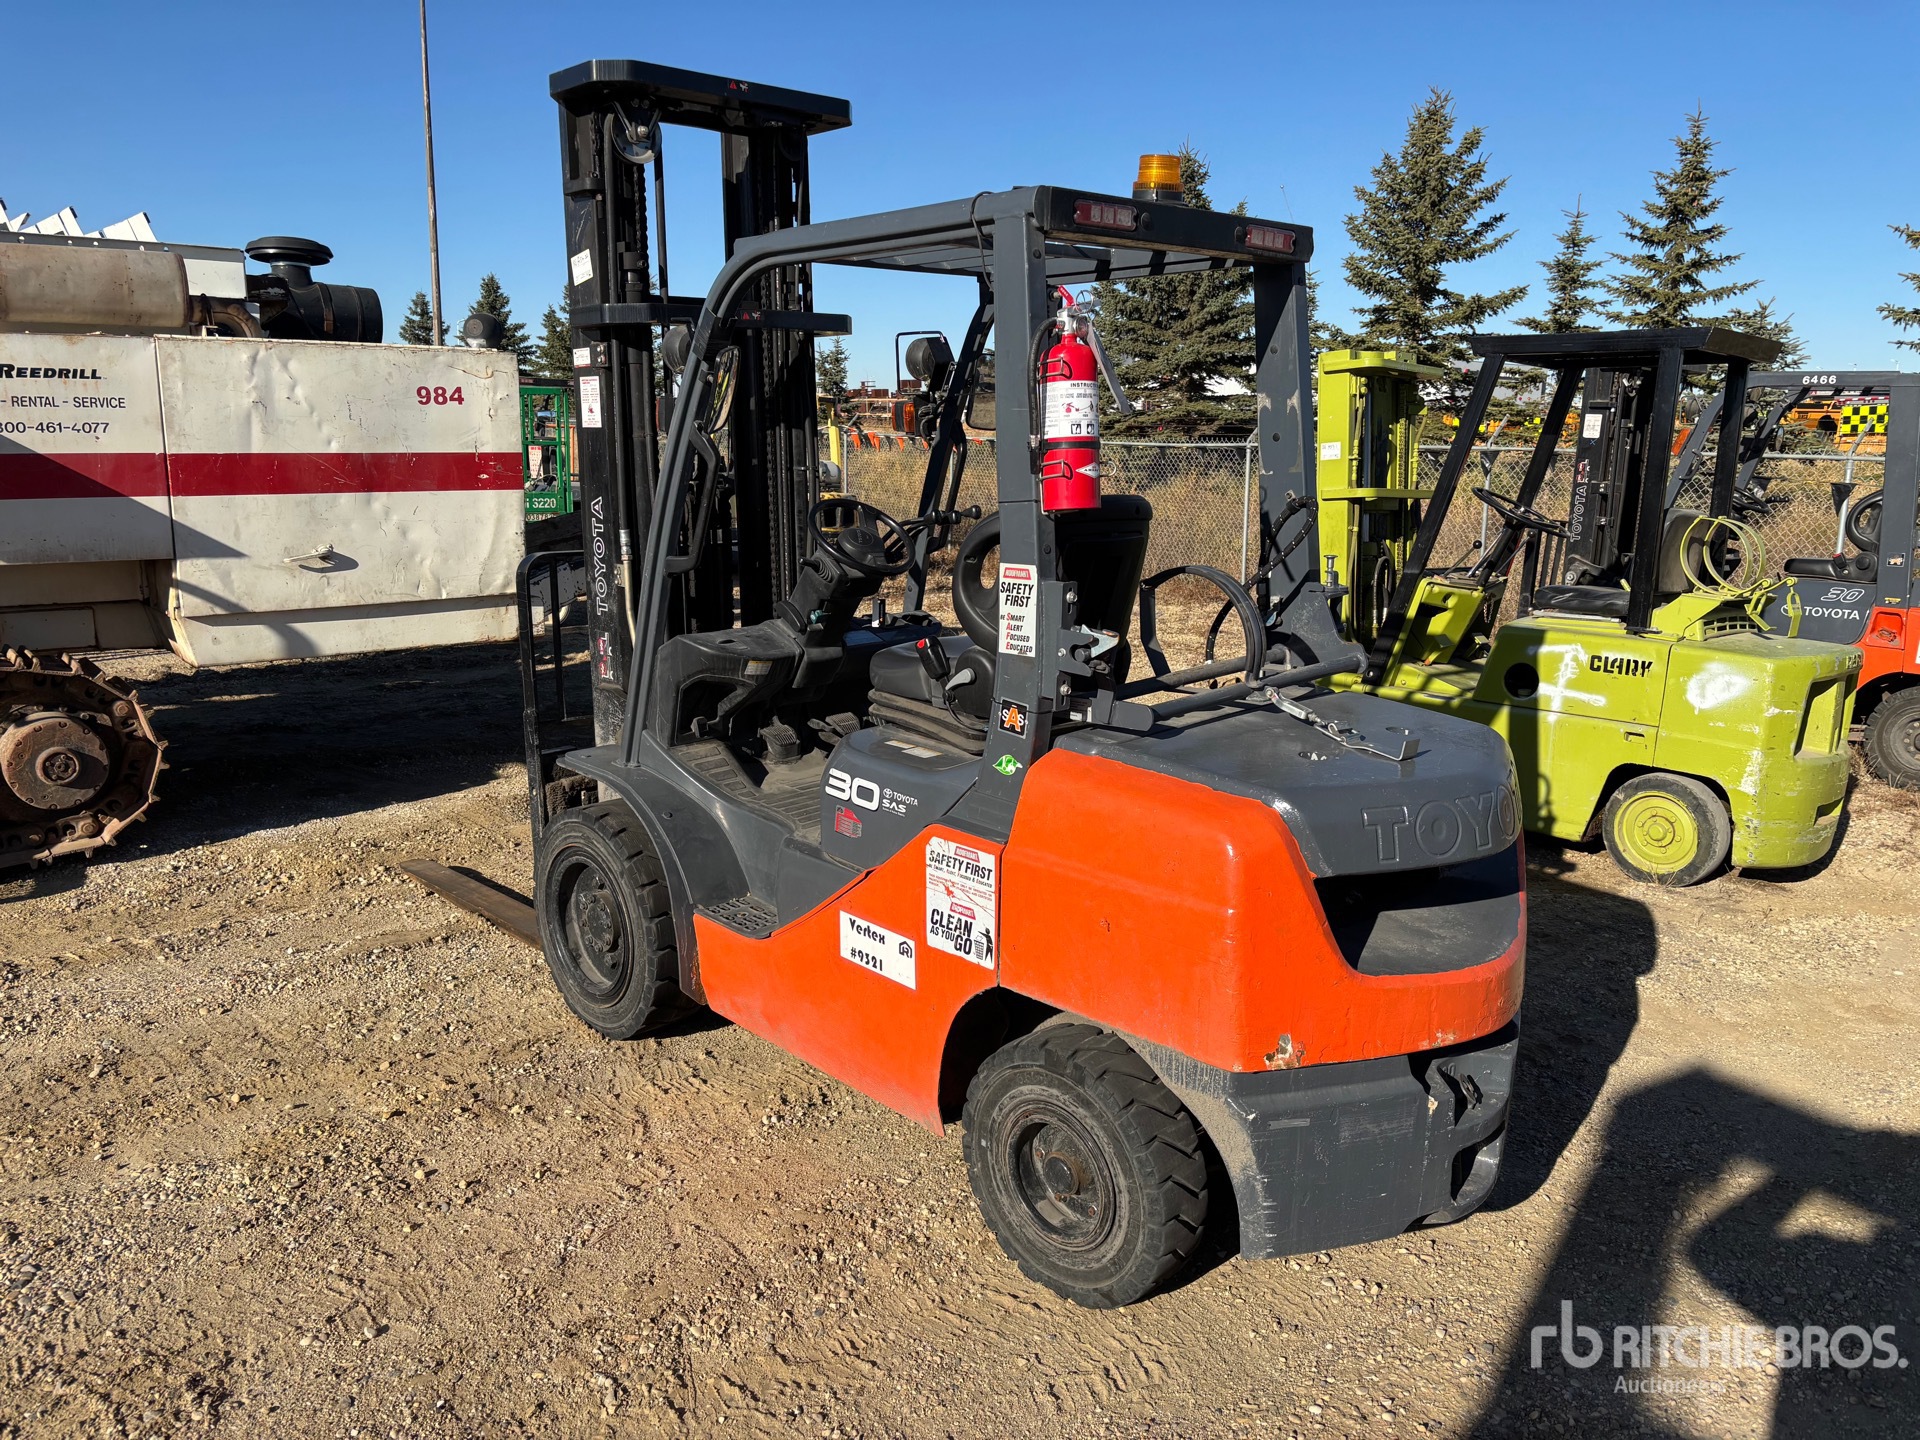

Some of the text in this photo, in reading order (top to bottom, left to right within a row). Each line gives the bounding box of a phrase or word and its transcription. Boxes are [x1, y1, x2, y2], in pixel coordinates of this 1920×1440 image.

[0, 363, 102, 380] REEDRILL
[1802, 375, 1837, 385] 6466
[11, 395, 60, 408] RENTAL
[73, 396, 126, 409] SERVICE
[416, 385, 465, 406] 984
[1570, 484, 1587, 542] TOYOTA
[590, 496, 609, 616] TOYOTA
[1000, 581, 1034, 596] SAFETY
[1820, 587, 1865, 603] 30
[1004, 594, 1031, 608] FIRST
[1006, 612, 1026, 623] SMART
[1803, 606, 1860, 620] TOYOTA
[1005, 622, 1024, 632] ALERT
[1005, 631, 1031, 643] FOCUSED
[1005, 641, 1033, 653] EDUCATED
[825, 768, 880, 811] 30
[882, 799, 907, 813] SAS
[893, 791, 919, 806] TOYOTA
[1361, 784, 1522, 864] TOYO
[928, 850, 964, 871] SAFETY
[965, 861, 993, 881] FIRST
[849, 917, 885, 945] Vertex
[930, 908, 973, 938] CLEAN
[929, 925, 973, 955] AS YOU GO
[850, 946, 883, 972] #9321
